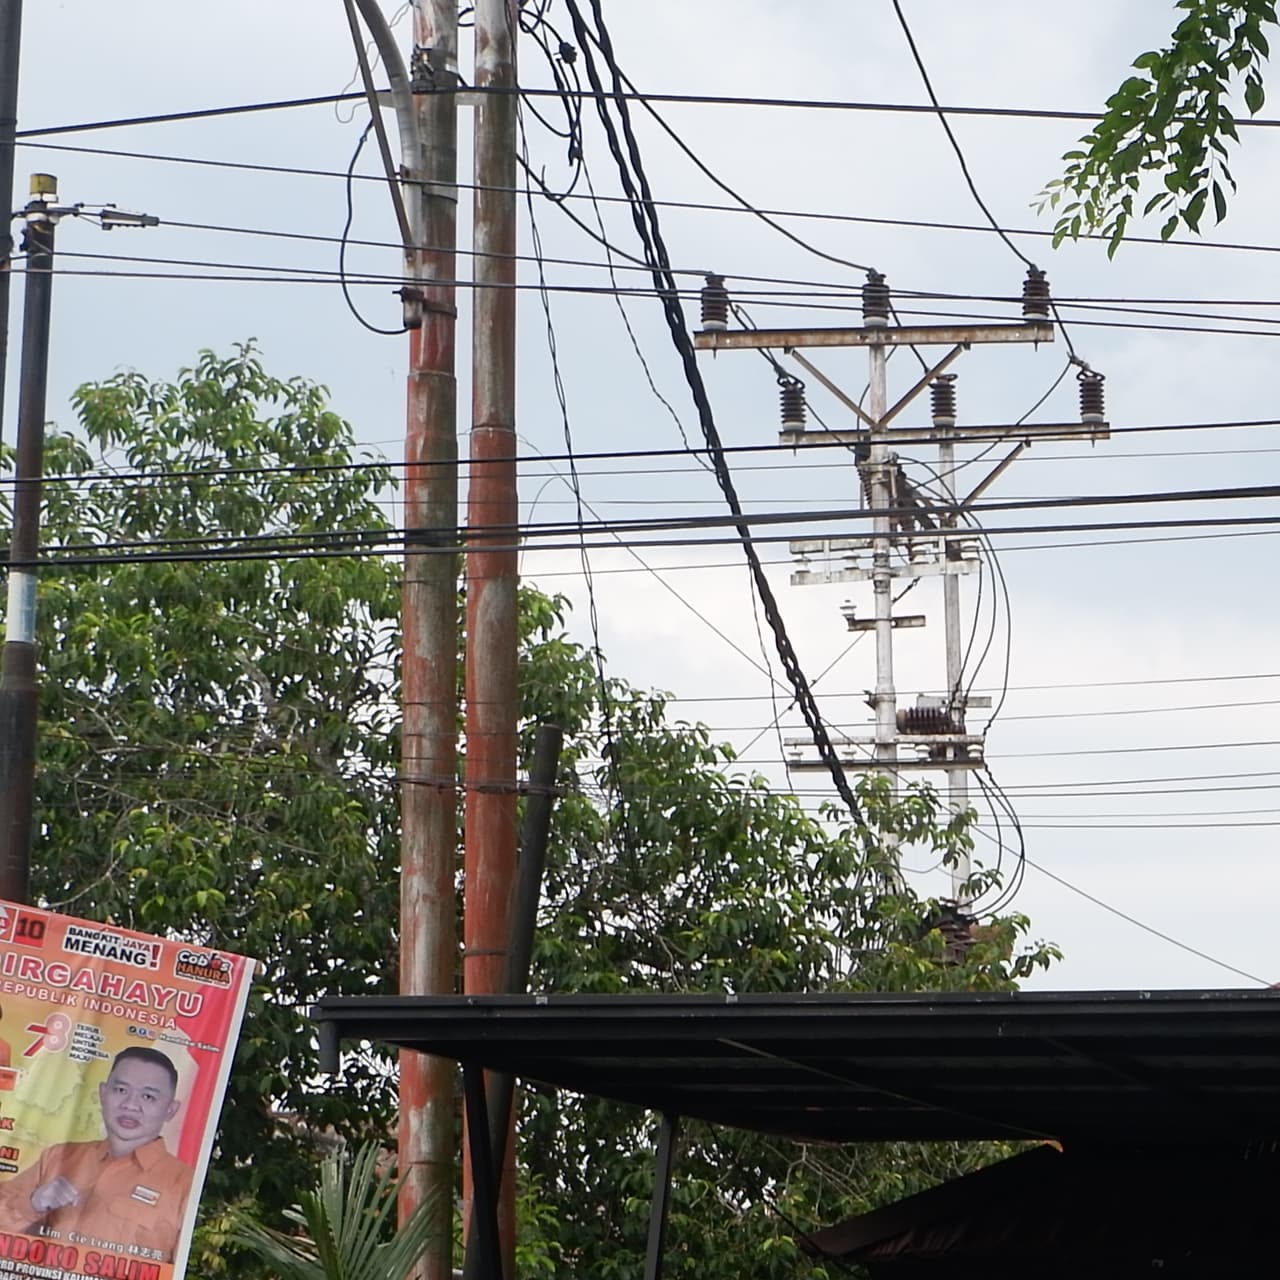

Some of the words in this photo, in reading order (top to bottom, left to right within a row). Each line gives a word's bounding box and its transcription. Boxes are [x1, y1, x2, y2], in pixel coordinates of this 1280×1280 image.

[16, 917, 45, 940] 10
[68, 927, 120, 945] BANGKIT
[124, 938, 150, 951] JAYA
[0, 951, 204, 1017] IRGAHAYU
[84, 997, 177, 1030] INDONESIA
